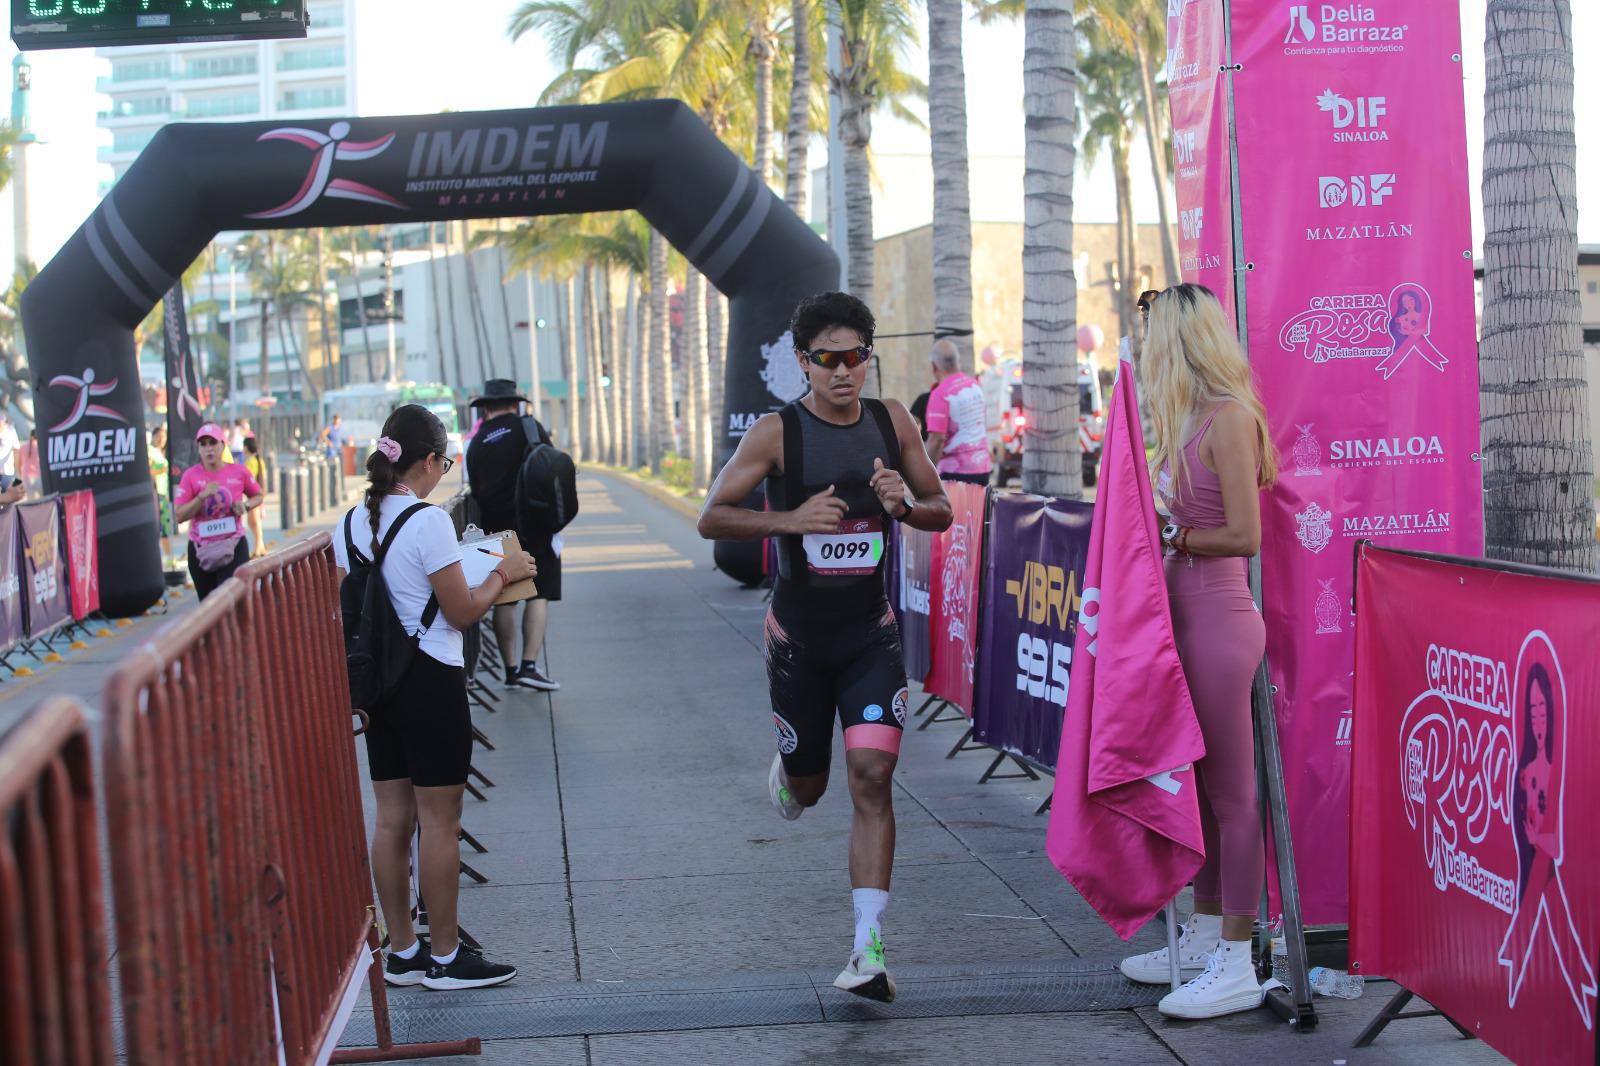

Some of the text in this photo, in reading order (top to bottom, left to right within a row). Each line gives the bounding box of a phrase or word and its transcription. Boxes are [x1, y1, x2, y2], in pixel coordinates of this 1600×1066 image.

[1321, 4, 1375, 23] Delia
[1284, 44, 1404, 56] Confianza para tu diagnóstico
[1333, 96, 1386, 128] DIF
[1333, 131, 1389, 142] SINALOA
[408, 122, 609, 177] IMDEM
[405, 170, 598, 192] INSTITUTO MUNICIPAL DEL DEPORTE
[1318, 173, 1396, 208] DIF
[1310, 294, 1386, 309] CARRERA
[1279, 309, 1389, 359] Rosa
[47, 427, 137, 464] IMDEM
[1330, 436, 1444, 460] SINALOA
[1330, 460, 1380, 469] GOBIERNO
[207, 523, 226, 532] 0911
[1342, 509, 1450, 532] MAZATLÁN
[821, 542, 870, 559] 0099
[1006, 560, 1081, 631] VIBRA
[1426, 644, 1511, 717] CARRERA
[1400, 689, 1513, 868] Rosa
